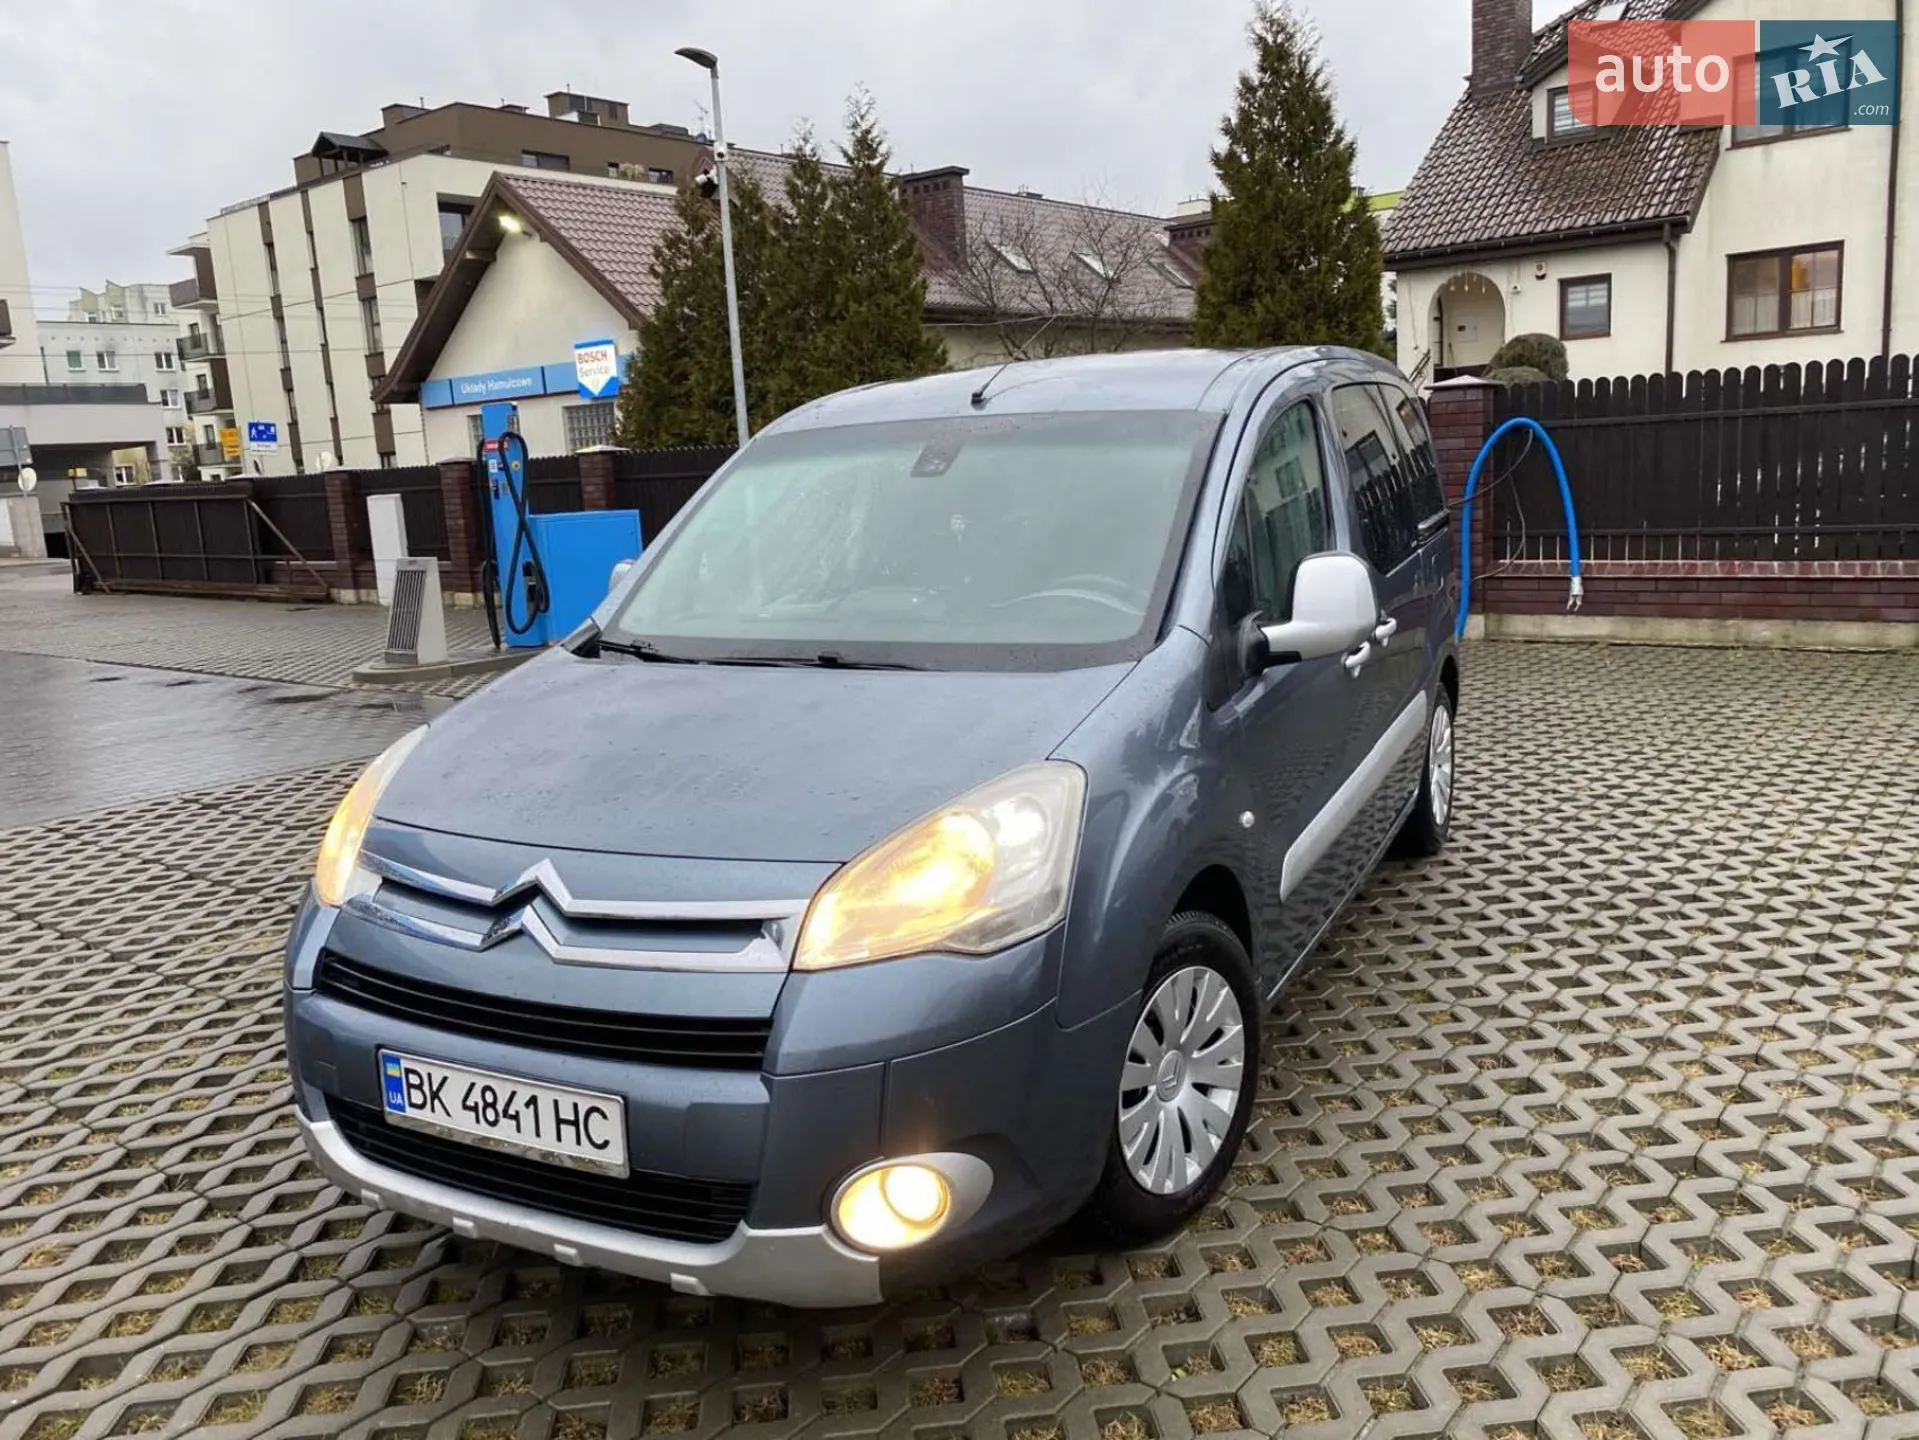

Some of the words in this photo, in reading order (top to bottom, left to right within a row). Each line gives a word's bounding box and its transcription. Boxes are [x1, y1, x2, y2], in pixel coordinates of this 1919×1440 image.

[577, 349, 608, 364] BOSCH
[579, 364, 609, 378] Service
[388, 1091, 404, 1105] UA
[404, 1067, 451, 1117] BK
[462, 1082, 541, 1138] 4841
[553, 1099, 610, 1150] HC
